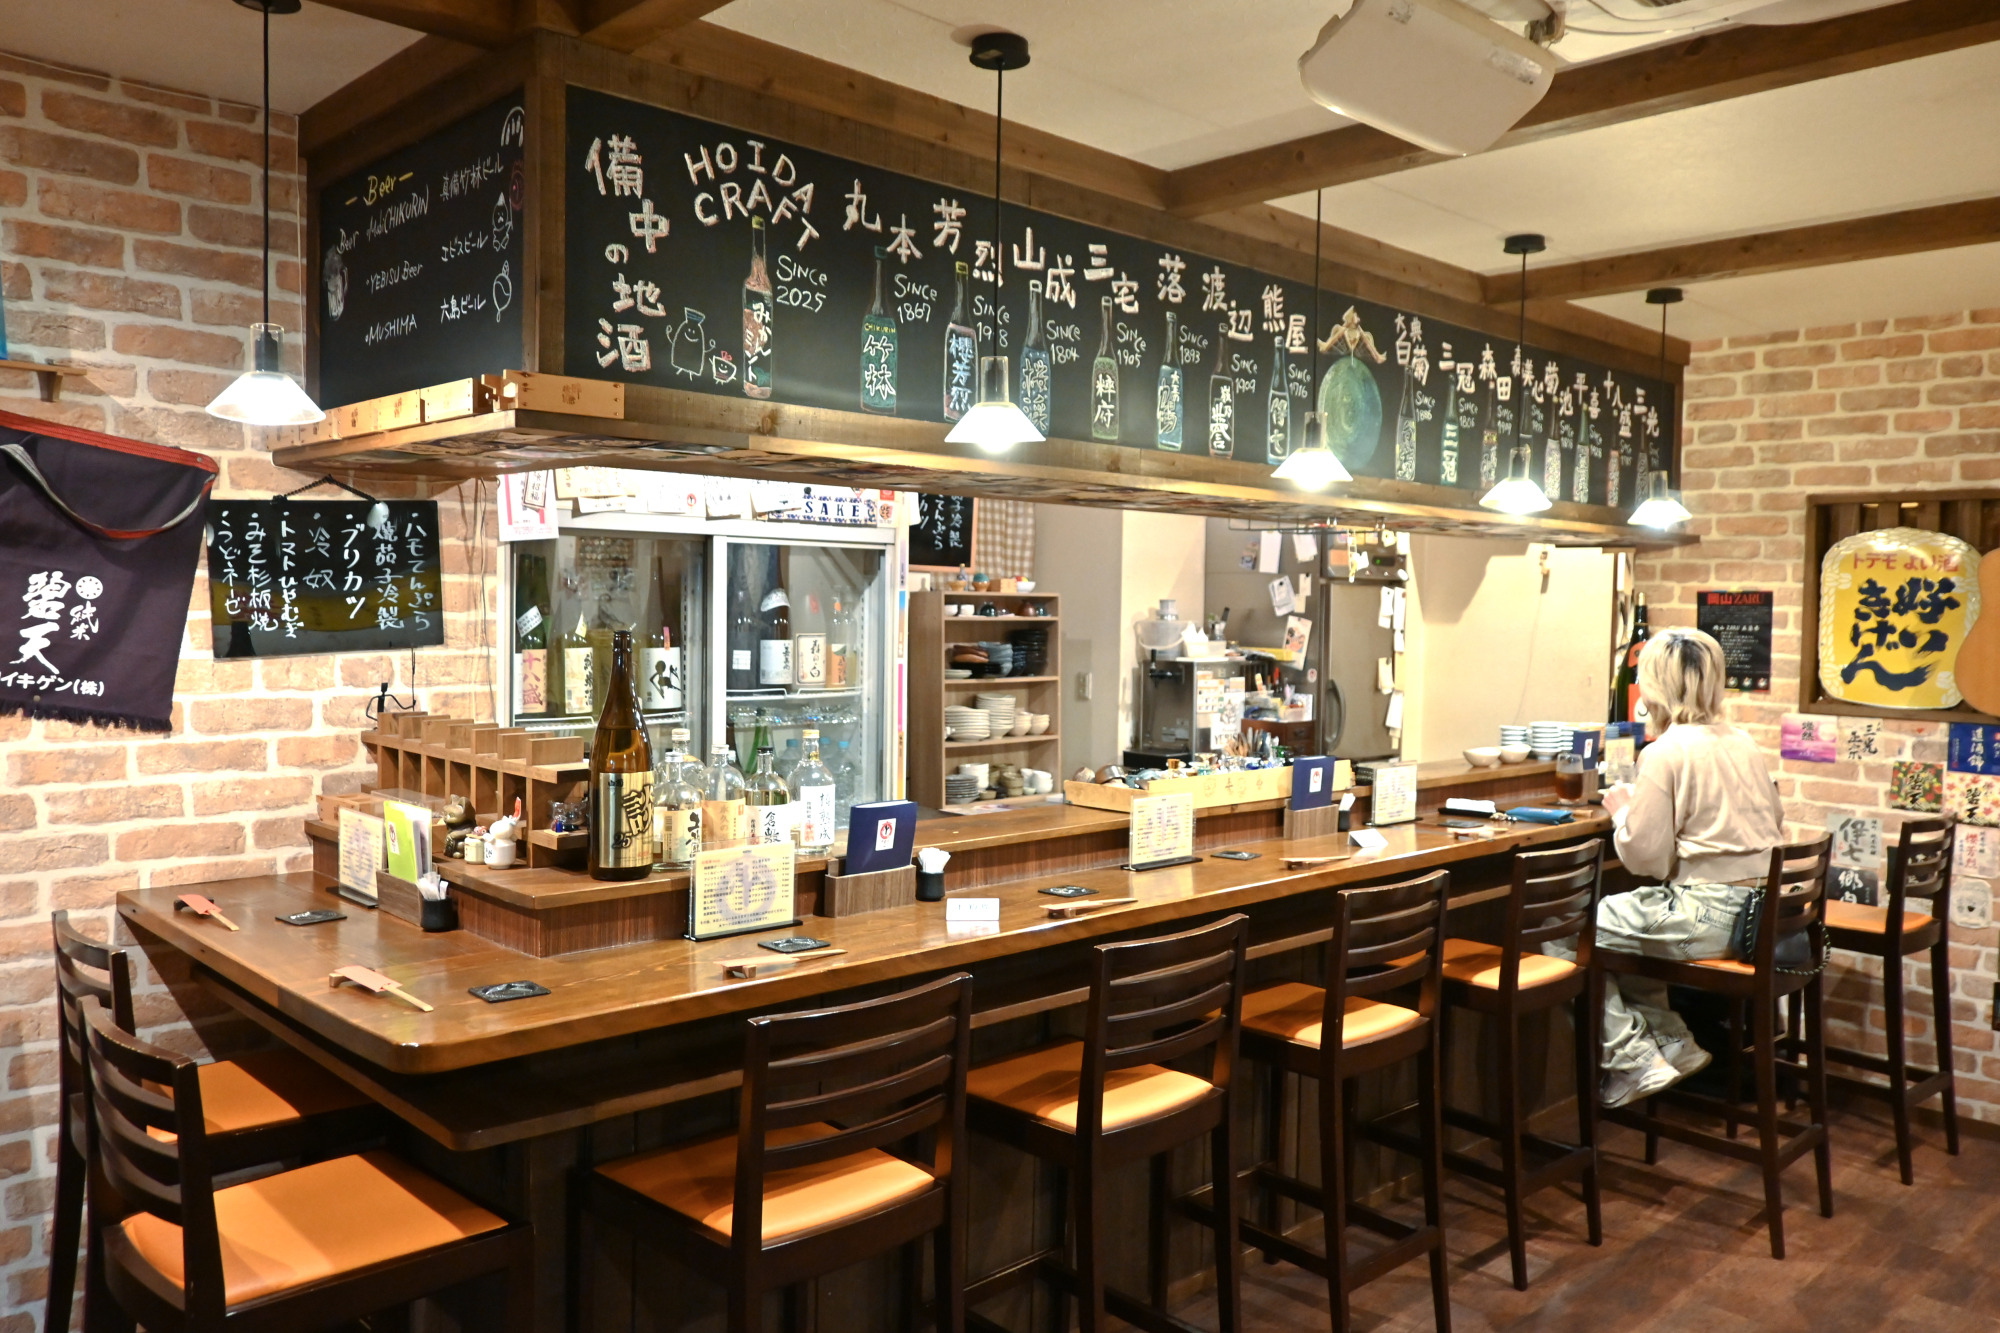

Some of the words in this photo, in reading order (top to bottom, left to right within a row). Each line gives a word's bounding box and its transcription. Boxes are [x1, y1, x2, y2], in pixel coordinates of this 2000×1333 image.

[843, 178, 923, 265] 丸本
[1013, 227, 1077, 310] 山成
[1083, 243, 1140, 314] 三宅
[1158, 252, 1187, 303] 落
[776, 285, 826, 313] 2025
[897, 303, 931, 323] 1867
[1202, 266, 1253, 342] 渡辺
[1262, 284, 1308, 354] 熊屋
[975, 321, 1009, 348] 198
[1117, 350, 1142, 368] 1905
[1438, 341, 1476, 394] 三冠
[1478, 342, 1511, 401] 森田
[1634, 387, 1660, 438] 三光
[302, 526, 337, 590] 冷奴
[0, 671, 105, 697] イキゲン(株)
